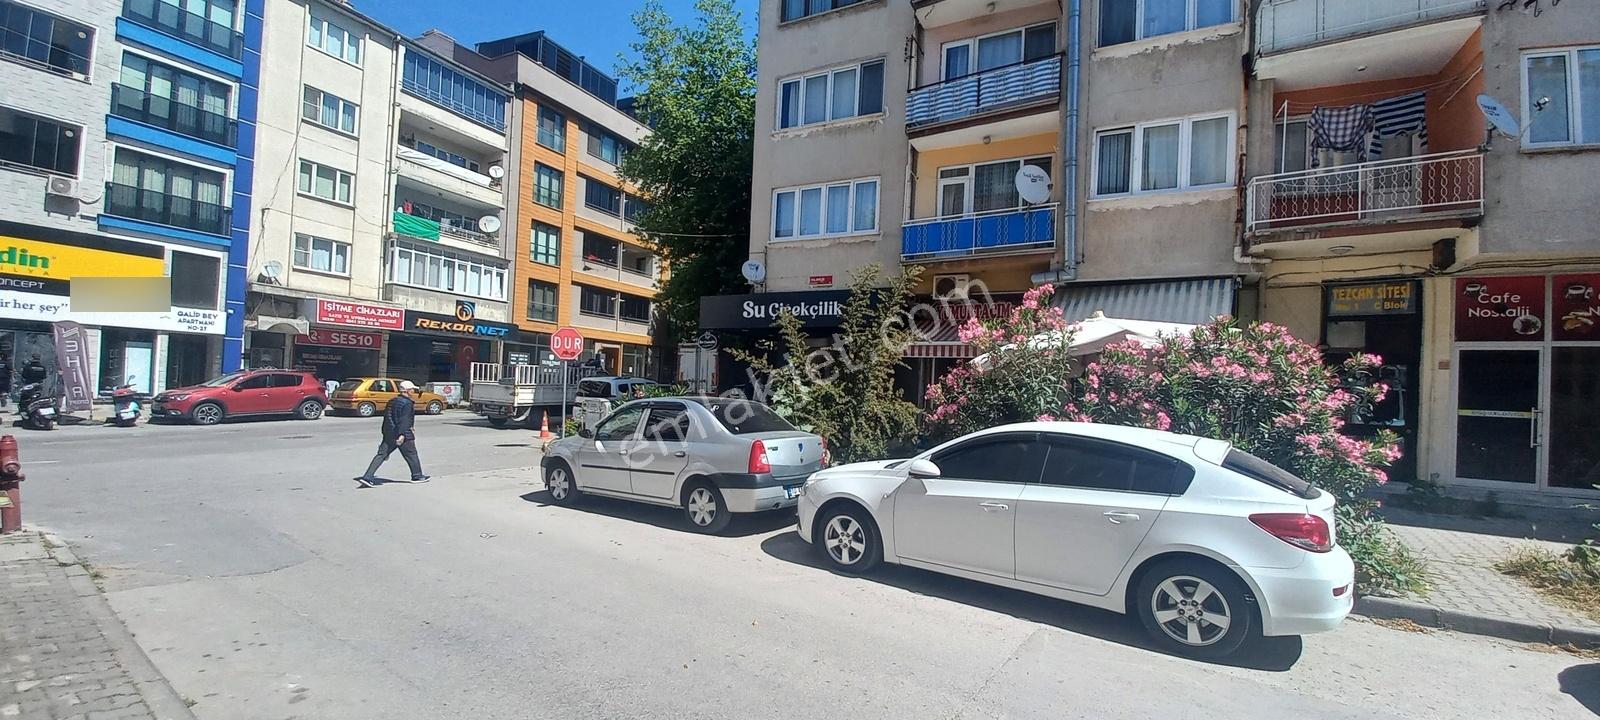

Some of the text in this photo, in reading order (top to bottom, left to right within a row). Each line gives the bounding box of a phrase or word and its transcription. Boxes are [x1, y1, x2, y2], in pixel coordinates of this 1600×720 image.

[1332, 282, 1411, 300] TEZCAN SİTESİ
[1477, 292, 1521, 304] Cafe
[13, 299, 36, 310] her
[324, 301, 400, 318] İŞİTME CİHAZLARI
[742, 301, 765, 318] Su
[202, 312, 218, 320] BEY
[331, 332, 373, 346] SES10
[553, 336, 581, 350] DUR
